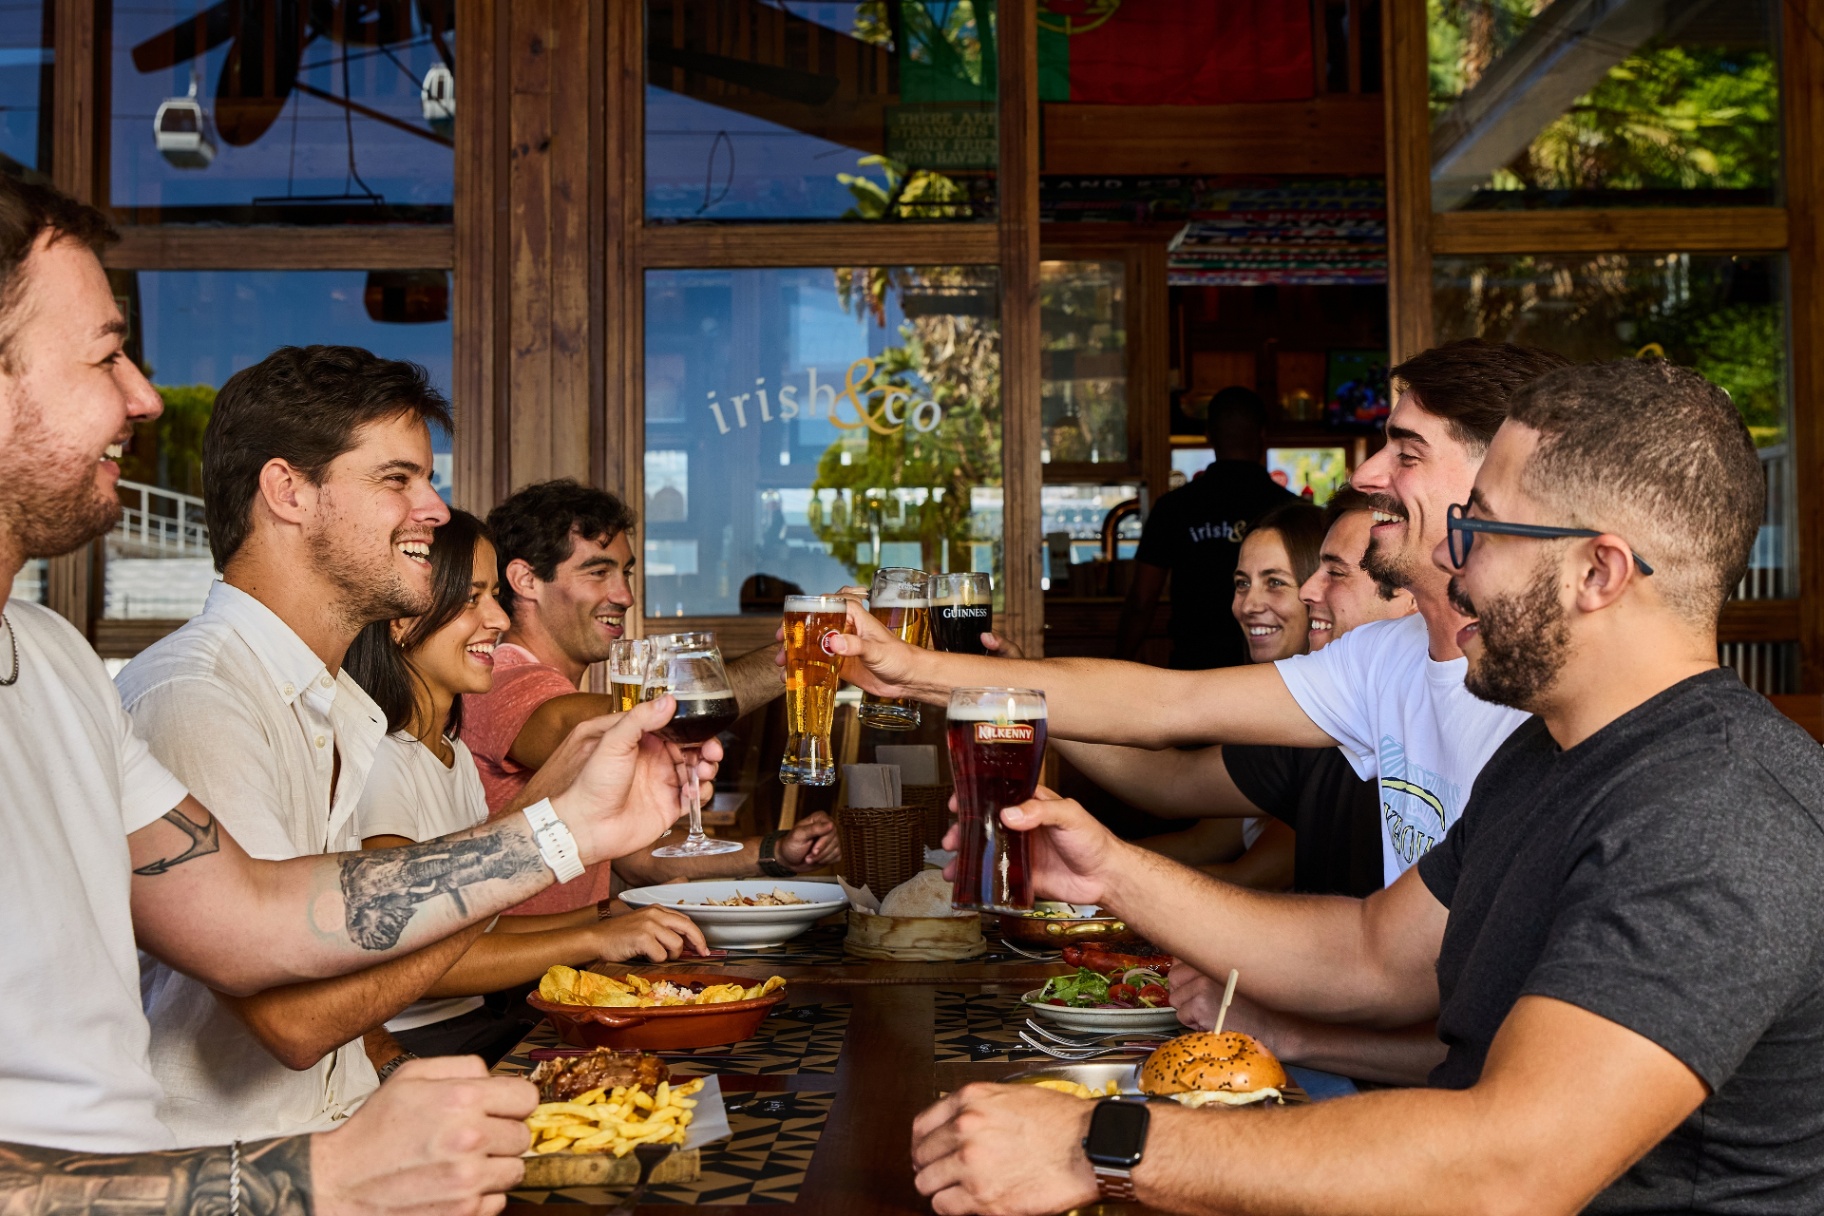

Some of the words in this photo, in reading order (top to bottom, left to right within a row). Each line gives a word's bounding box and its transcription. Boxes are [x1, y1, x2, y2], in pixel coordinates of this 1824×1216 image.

[898, 111, 953, 125] THERE
[890, 125, 989, 139] STRANGERS
[905, 138, 948, 151] ONLY
[892, 151, 932, 164] WHO
[1188, 519, 1248, 543] irish&
[942, 607, 988, 619] GUINNESS
[977, 724, 1033, 740] KILKENNY
